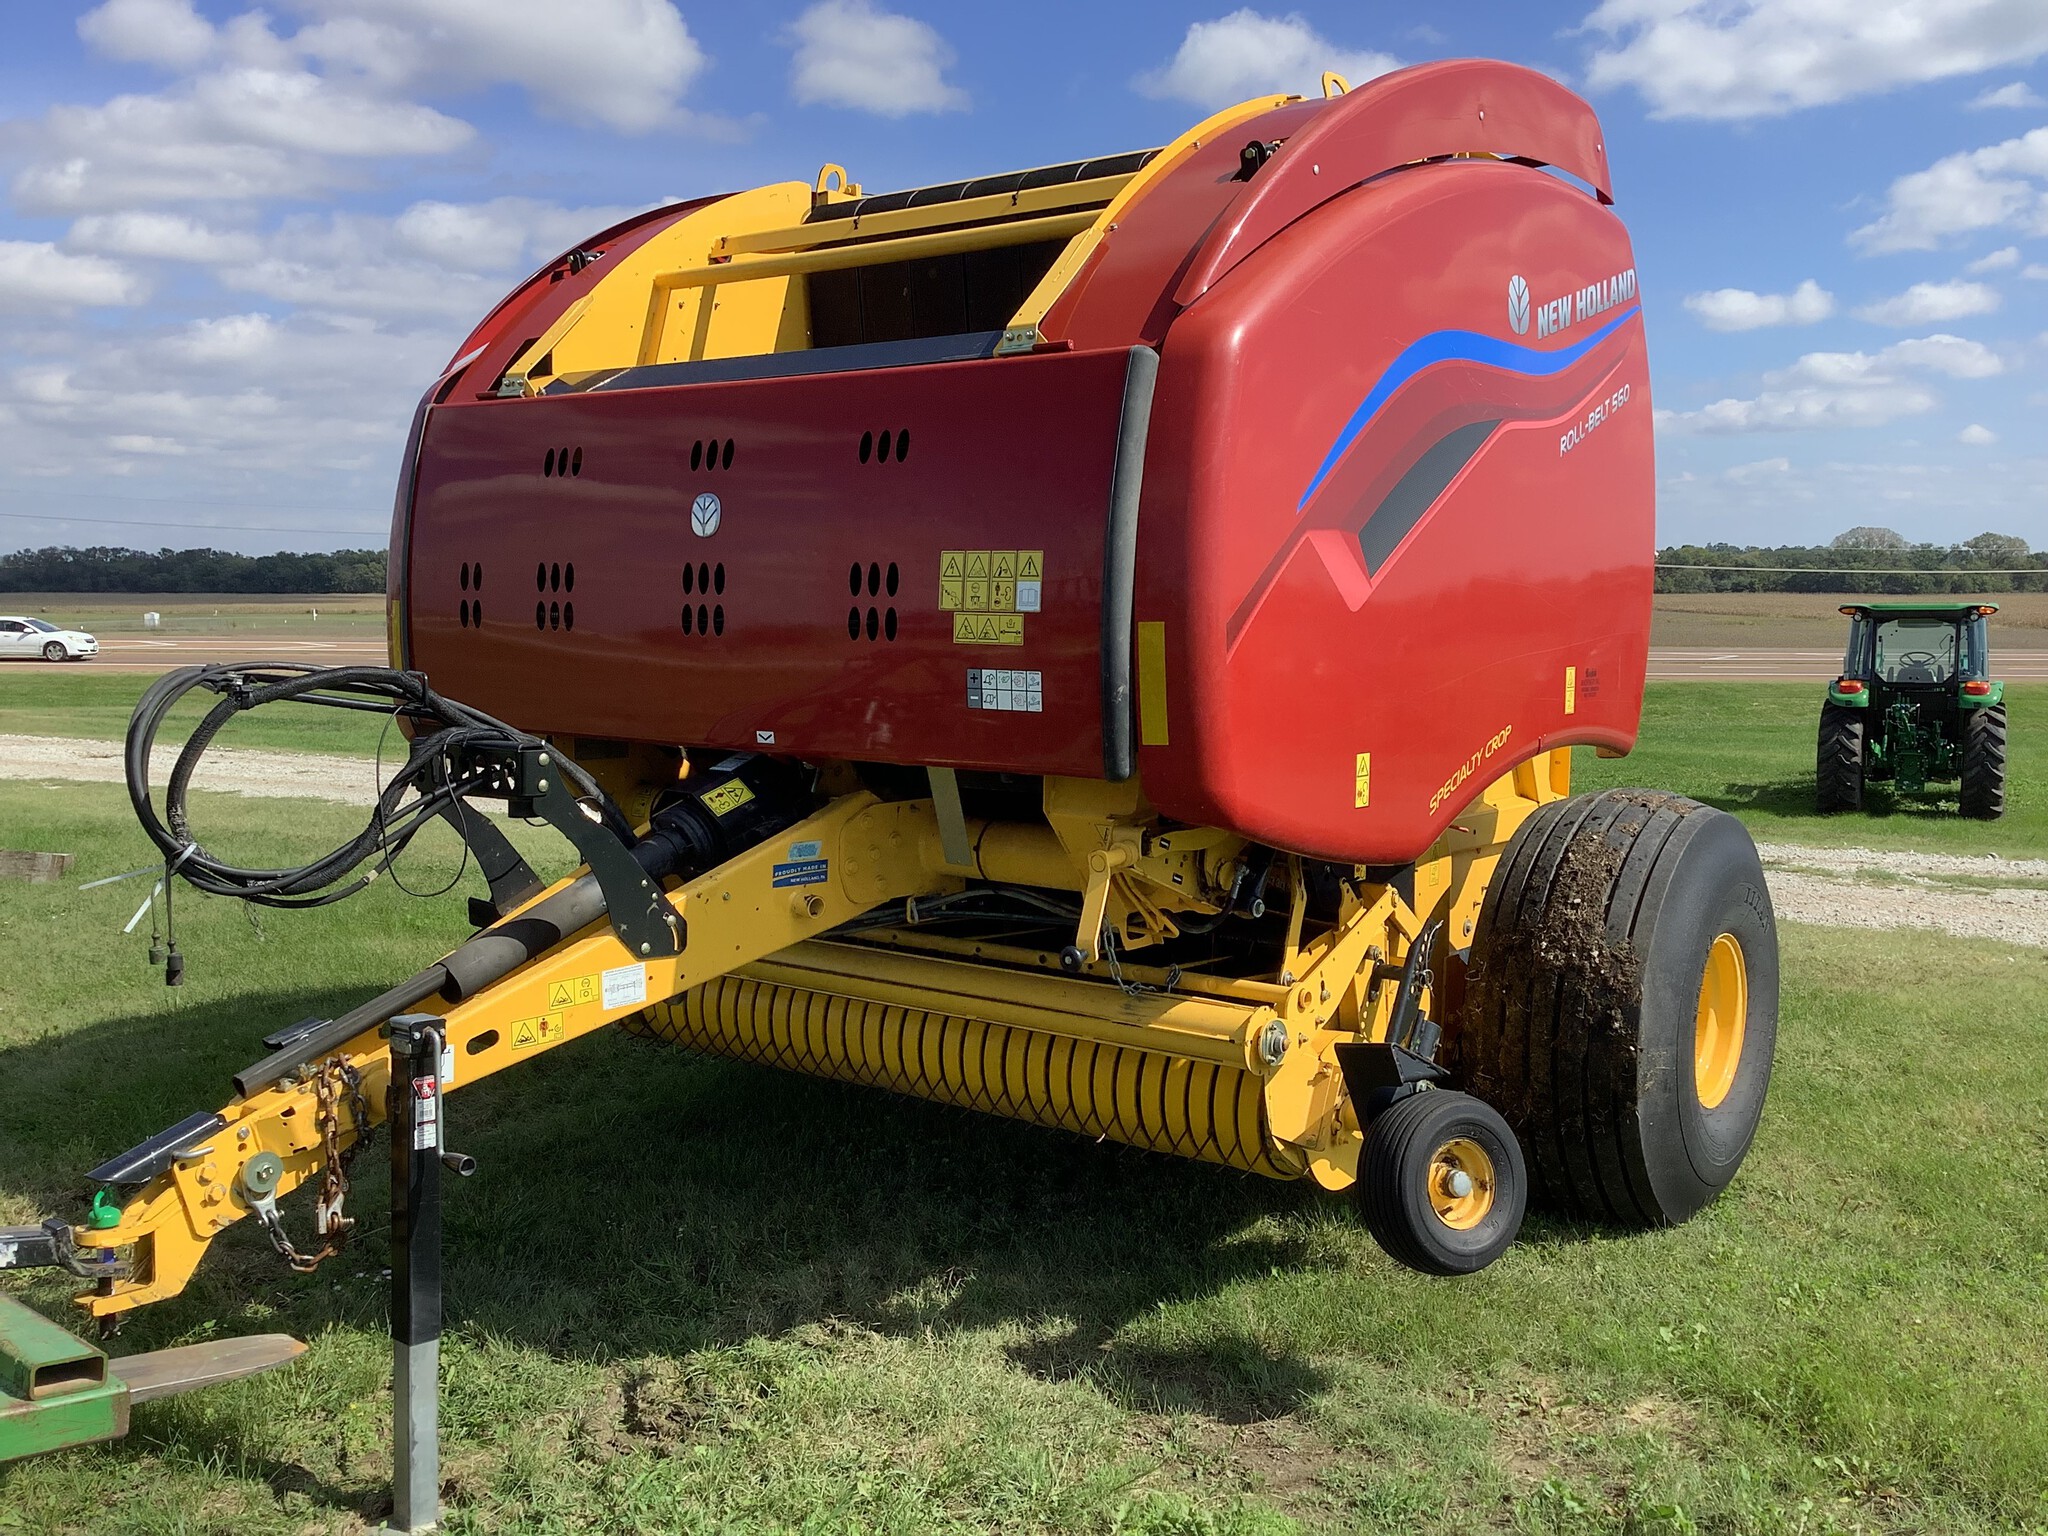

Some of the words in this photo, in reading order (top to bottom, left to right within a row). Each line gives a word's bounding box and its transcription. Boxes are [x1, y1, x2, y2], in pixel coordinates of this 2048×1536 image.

[1537, 294, 1573, 340] NEW
[1576, 268, 1637, 323] HOLLAND
[1560, 397, 1610, 458] ROLL-BELT
[1611, 383, 1631, 414] 560
[1429, 747, 1484, 817] SPECIALTY
[1485, 724, 1512, 759] CROP
[774, 867, 801, 877] PROUDLY
